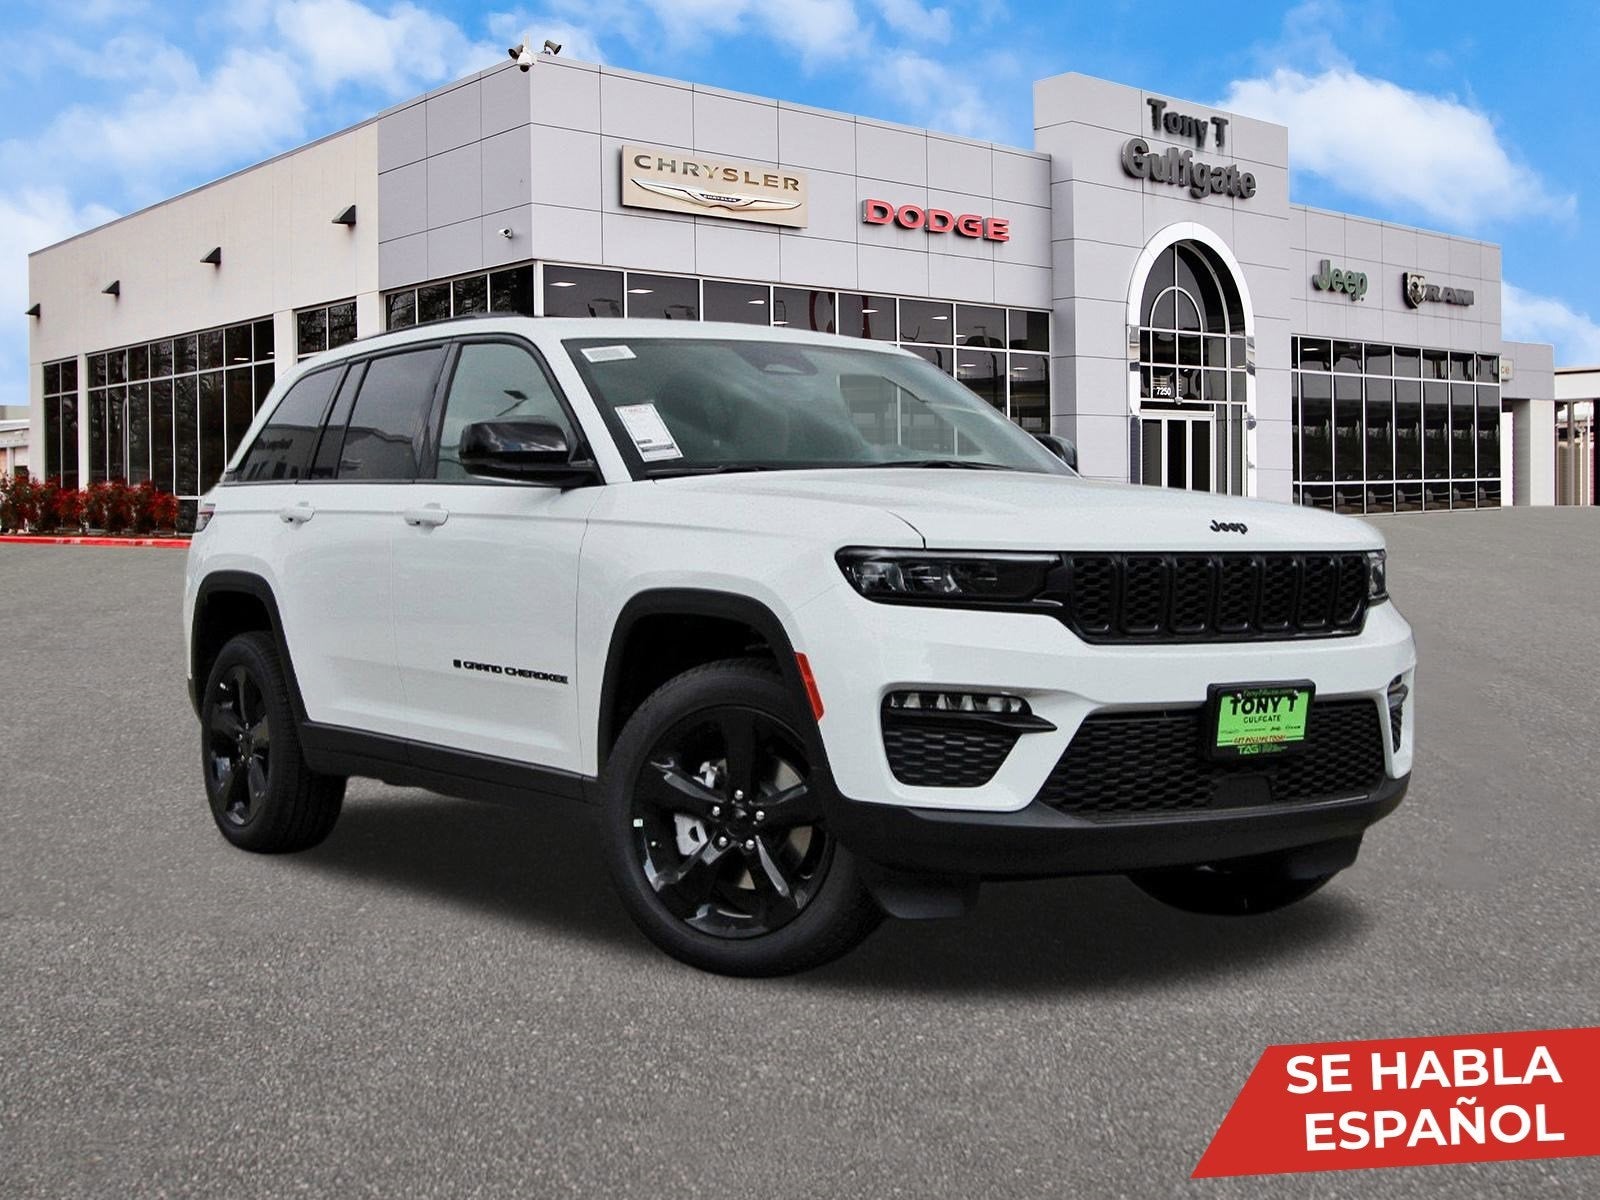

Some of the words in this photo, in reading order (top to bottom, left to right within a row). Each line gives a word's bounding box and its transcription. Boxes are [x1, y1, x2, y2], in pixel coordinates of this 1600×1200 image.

[1146, 98, 1207, 148] Tony
[1211, 116, 1229, 148] T
[633, 153, 800, 192] CHRYSLER
[1121, 138, 1257, 200] Gulfgate
[862, 198, 1010, 242] DODGE
[1312, 259, 1368, 302] Jeep
[1425, 284, 1474, 306] RAM
[1156, 386, 1171, 396] 7250
[1210, 519, 1248, 535] Jeep
[463, 660, 503, 674] GRAND
[504, 666, 568, 685] CHEROKEE
[1230, 695, 1282, 715] TONY
[1287, 694, 1298, 712] T
